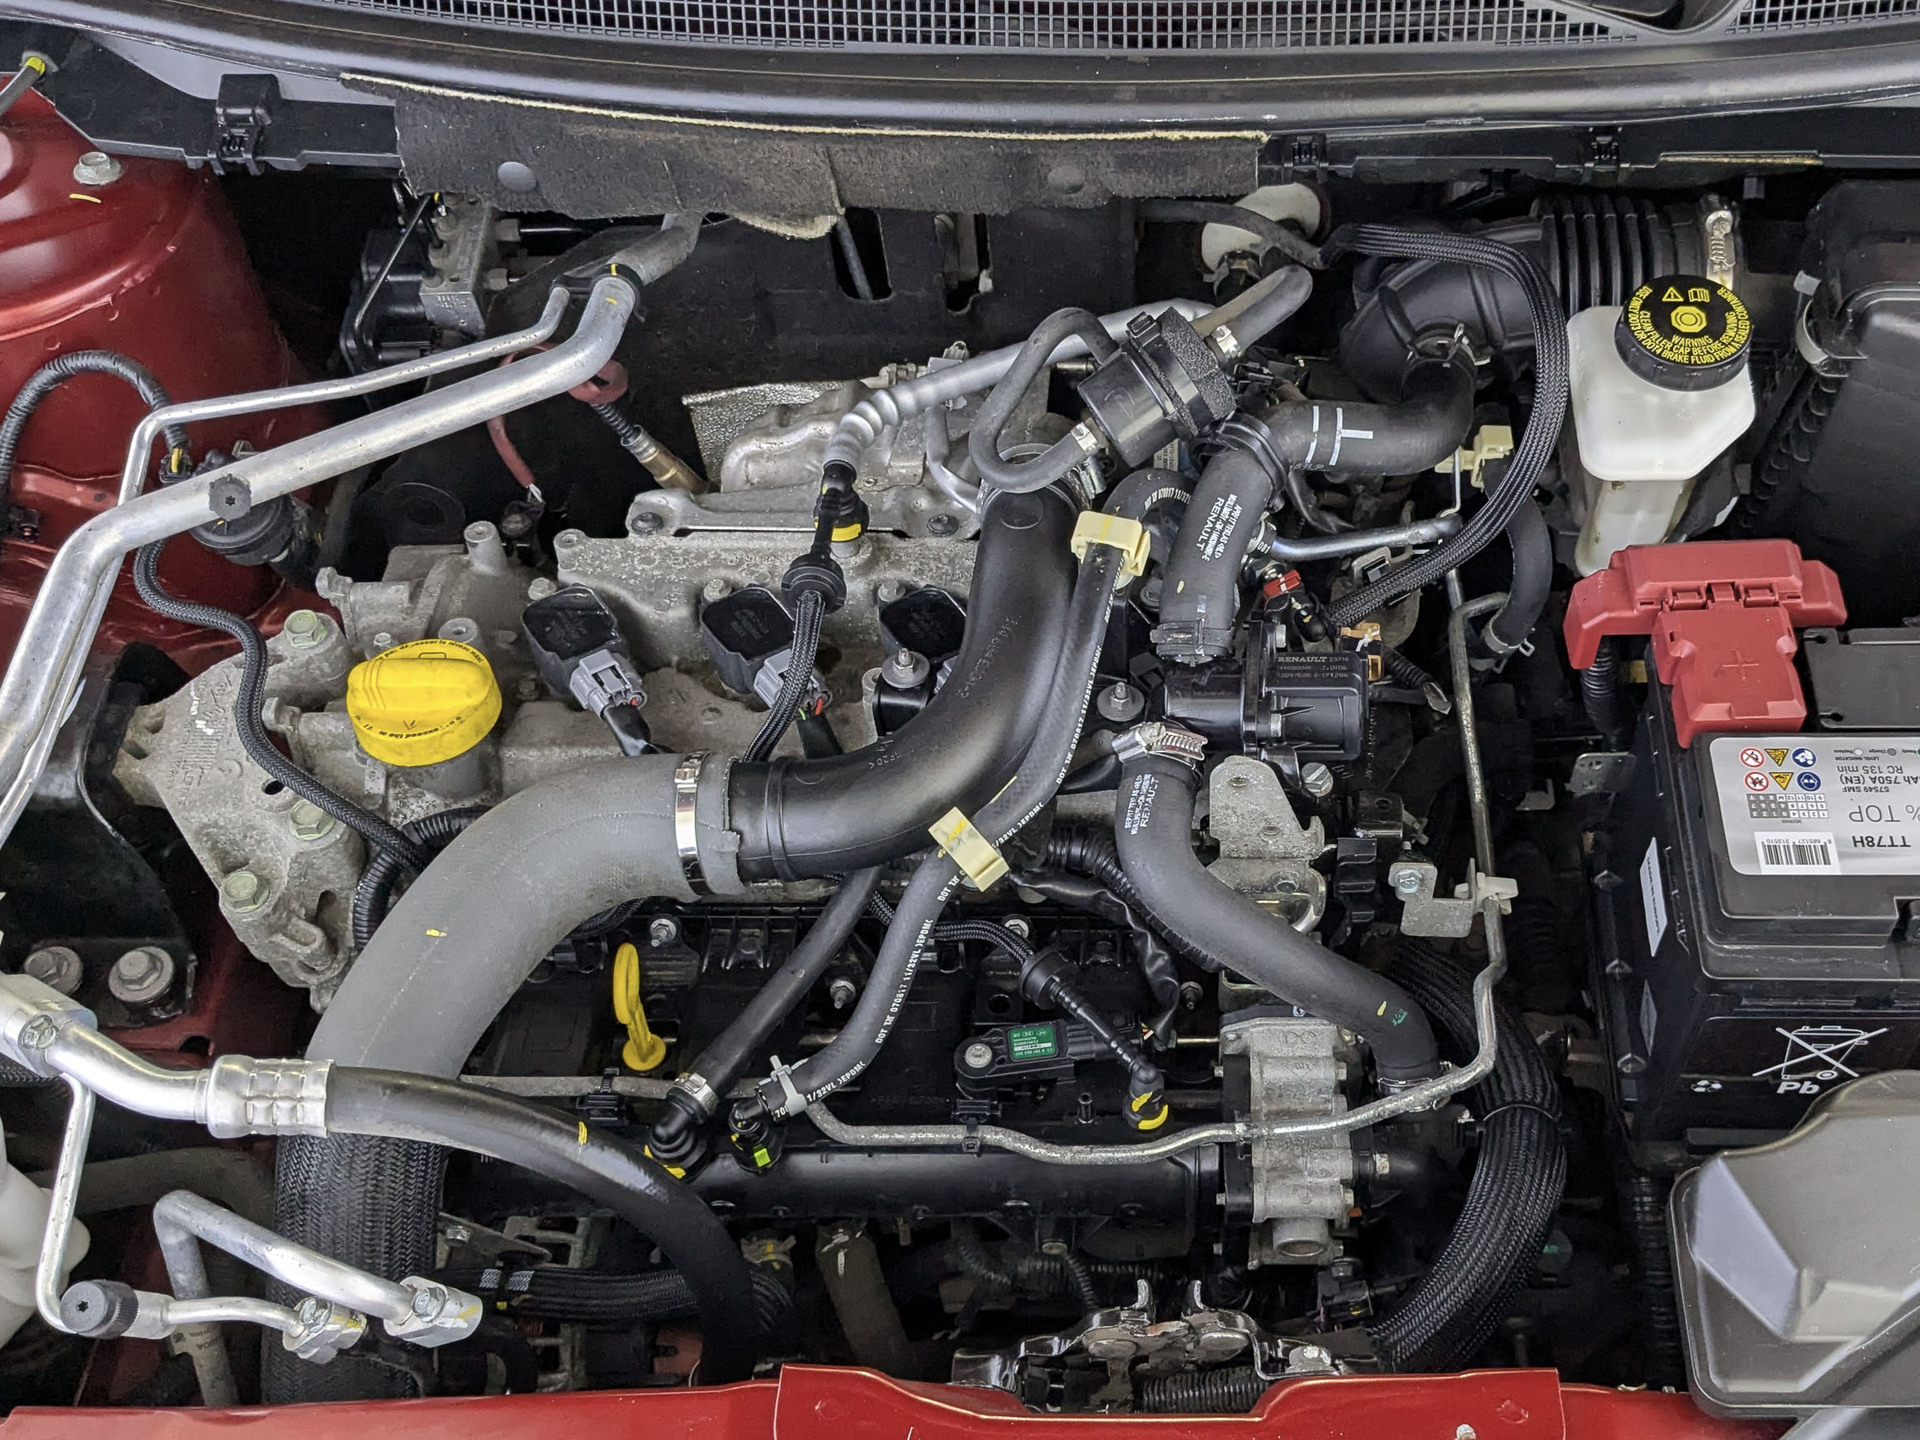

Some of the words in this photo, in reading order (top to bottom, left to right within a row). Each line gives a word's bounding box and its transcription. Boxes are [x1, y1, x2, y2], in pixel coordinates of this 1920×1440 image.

[1635, 286, 1653, 300] USE
[1628, 296, 1643, 313] ONLY
[1717, 286, 1749, 320] CONTAINER
[1628, 313, 1642, 331] DOT3
[1634, 330, 1647, 341] OR
[1640, 310, 1654, 332] CLEAN
[1647, 330, 1673, 350] FILLER
[1672, 344, 1691, 355] CAP
[1692, 340, 1725, 355] BEFORE
[1719, 311, 1737, 345] REMOVING
[1734, 320, 1750, 344] SEALED
[1641, 338, 1663, 355] DOT4
[1671, 335, 1713, 348] WARNING
[1731, 341, 1742, 349] A
[1661, 349, 1690, 364] BRAKE
[1690, 354, 1715, 364] FLUID
[1713, 345, 1737, 361] FROM
[1196, 497, 1225, 551] RENAULT
[1056, 767, 1067, 785] DOT
[1070, 717, 1085, 750] 070817
[1837, 765, 1859, 774] min
[1862, 765, 1884, 775] 135
[1887, 765, 1904, 775] RC
[1840, 774, 1866, 785] (EN)
[1869, 775, 1901, 785] 750A
[1903, 776, 1920, 785] Ah
[1140, 776, 1159, 828] RENAULT
[1848, 804, 1901, 822] TOP
[1851, 835, 1911, 848] TT78H
[936, 886, 951, 902] DOT
[875, 1028, 888, 1044] DOT
[890, 984, 908, 1013] 070817
[903, 948, 922, 981] 11/32VL
[1776, 1080, 1820, 1094] Pb
